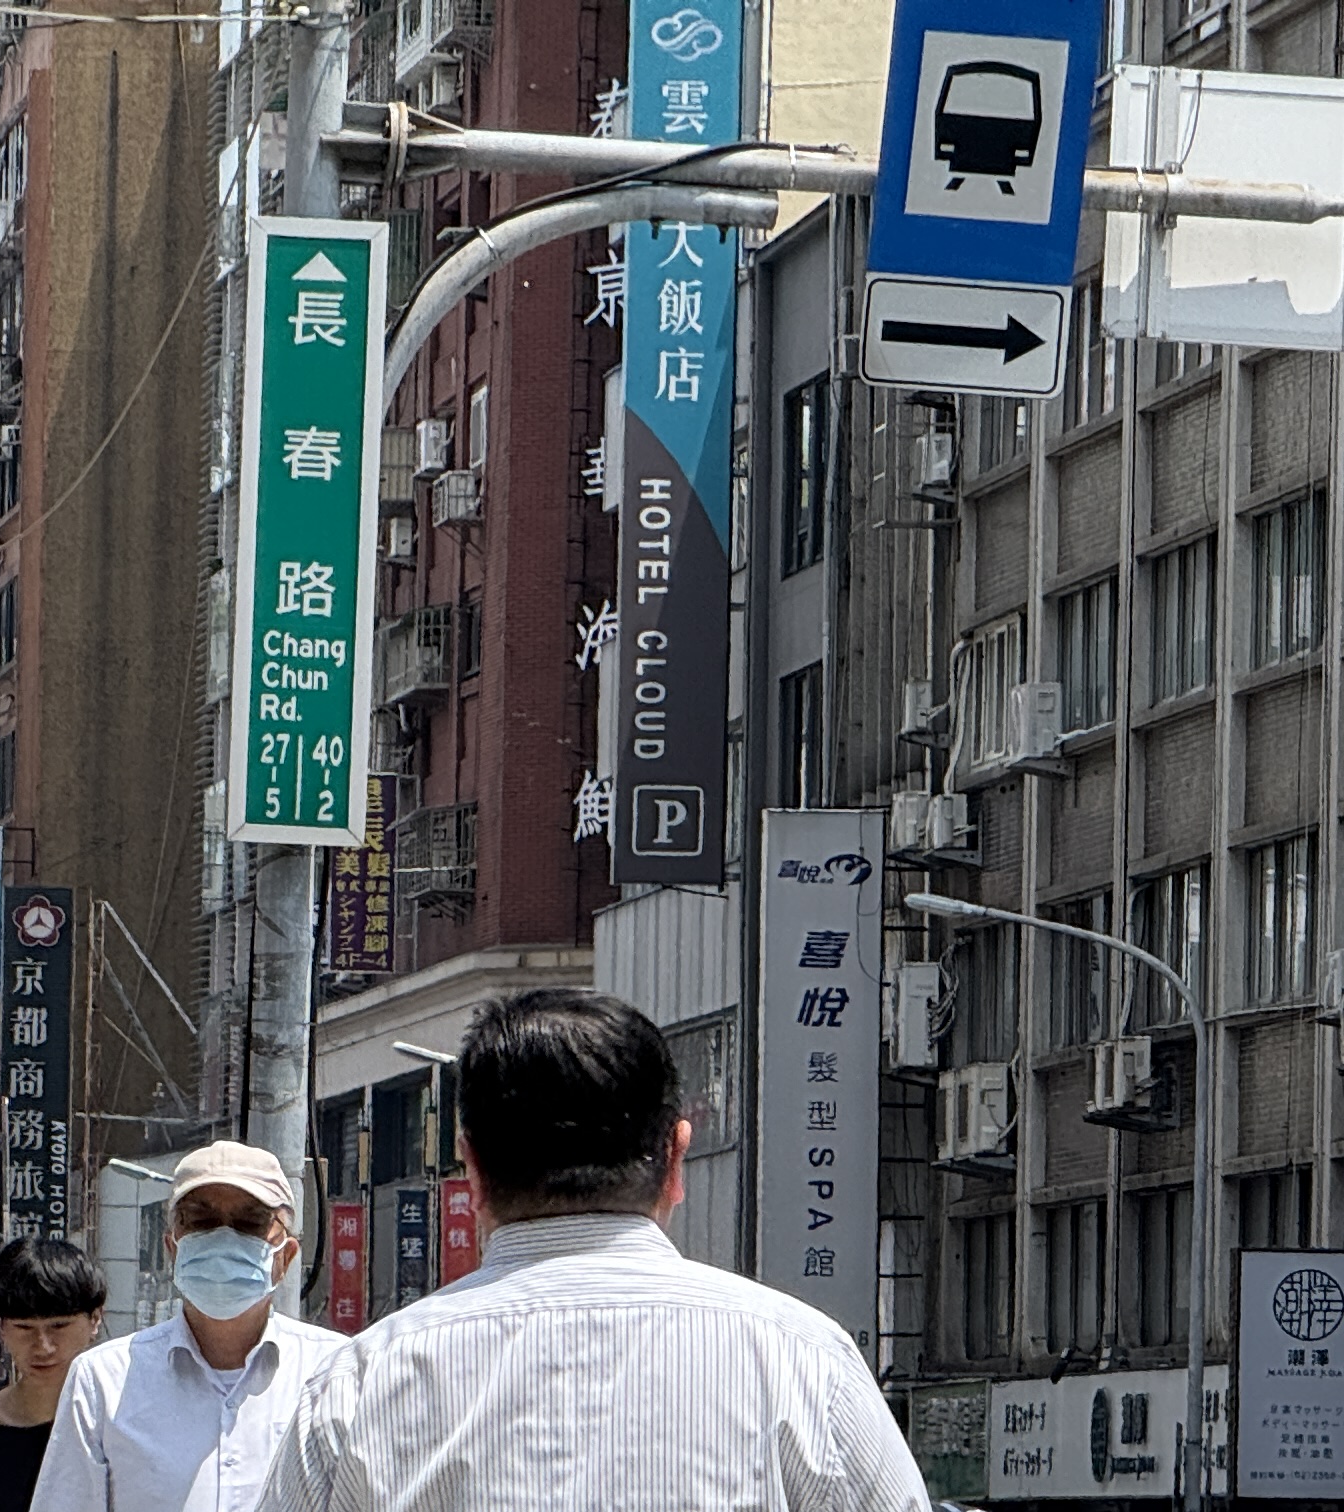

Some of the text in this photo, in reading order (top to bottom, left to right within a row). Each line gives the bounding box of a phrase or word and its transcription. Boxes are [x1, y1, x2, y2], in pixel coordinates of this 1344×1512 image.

[654, 79, 710, 402] 雲大飯店
[275, 290, 348, 618] 長春路
[637, 478, 672, 605] HOTEL
[262, 629, 347, 668] Chang
[261, 661, 329, 691] Chun
[633, 630, 668, 760] CLOUD
[259, 693, 303, 722] Rd.
[260, 733, 291, 765] 27
[311, 734, 345, 767] 40
[652, 798, 688, 844] P
[49, 1119, 67, 1176] KYOTO
